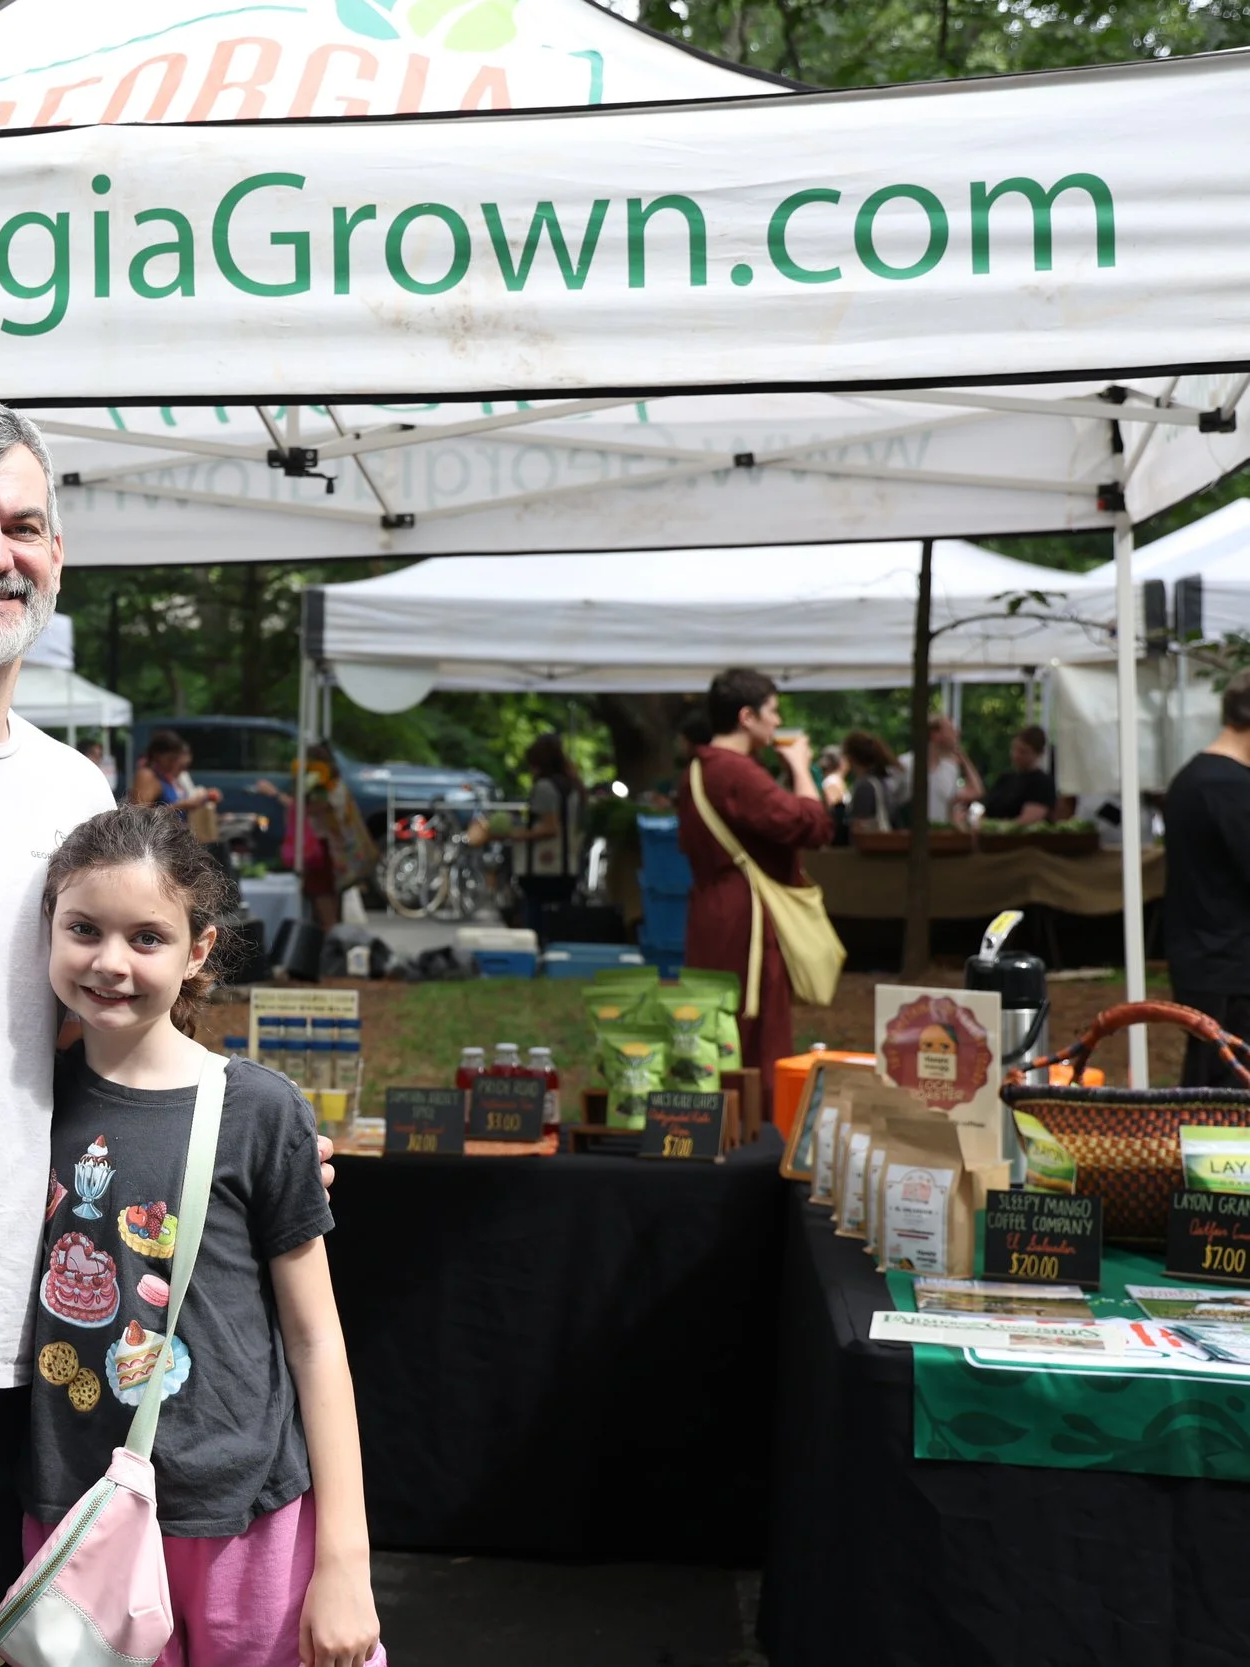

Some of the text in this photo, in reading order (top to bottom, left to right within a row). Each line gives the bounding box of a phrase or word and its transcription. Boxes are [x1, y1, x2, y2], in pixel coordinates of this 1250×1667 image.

[998, 1193, 1092, 1218] SLEEPY MANGO
[1173, 1192, 1214, 1214] LAYON
[987, 1212, 1093, 1236] COFFEE COMPANY
[1008, 1251, 1059, 1280] $20.00
[1202, 1244, 1247, 1273] $7.00
